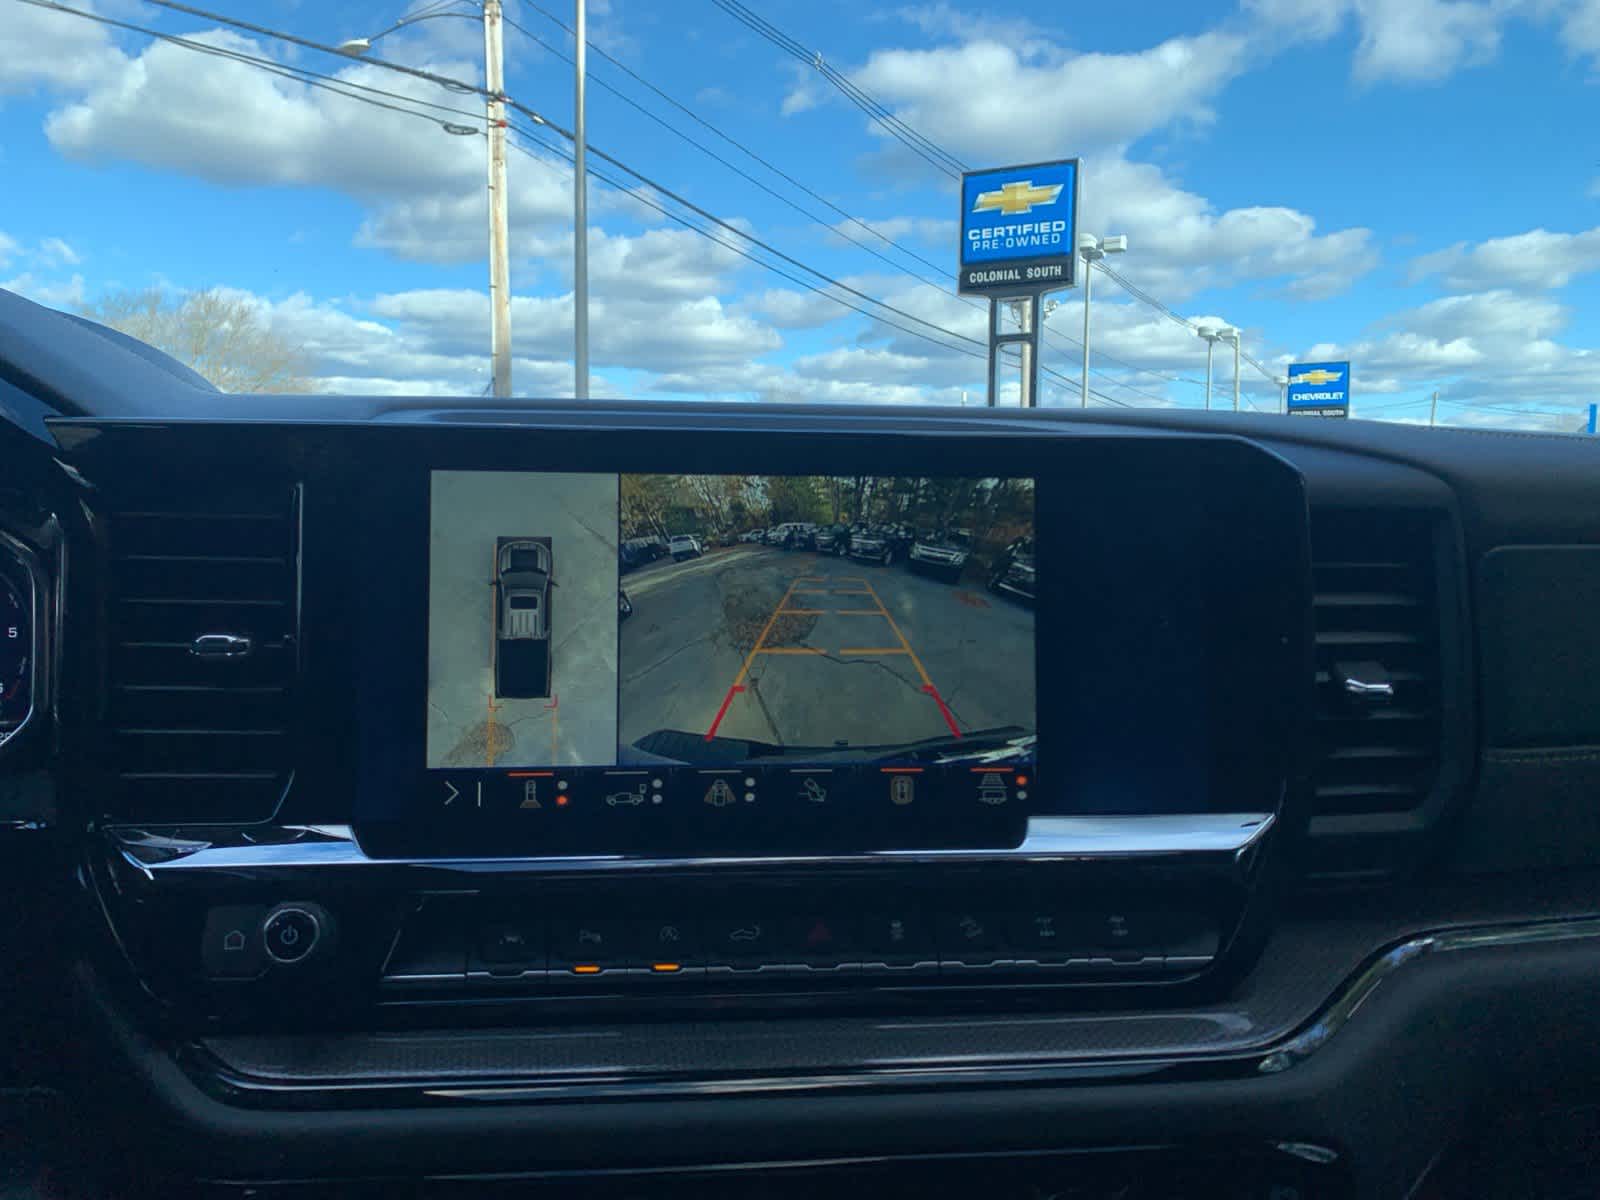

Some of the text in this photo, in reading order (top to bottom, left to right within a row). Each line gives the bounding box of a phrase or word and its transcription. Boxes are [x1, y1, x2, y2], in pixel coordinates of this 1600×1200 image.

[968, 220, 1066, 241] CERTIFIED
[972, 233, 1060, 251] PRE-OWNED
[969, 265, 1062, 283] COLONIAL SOUTH
[1292, 391, 1344, 401] CHEVROLET
[8, 627, 18, 638] 5
